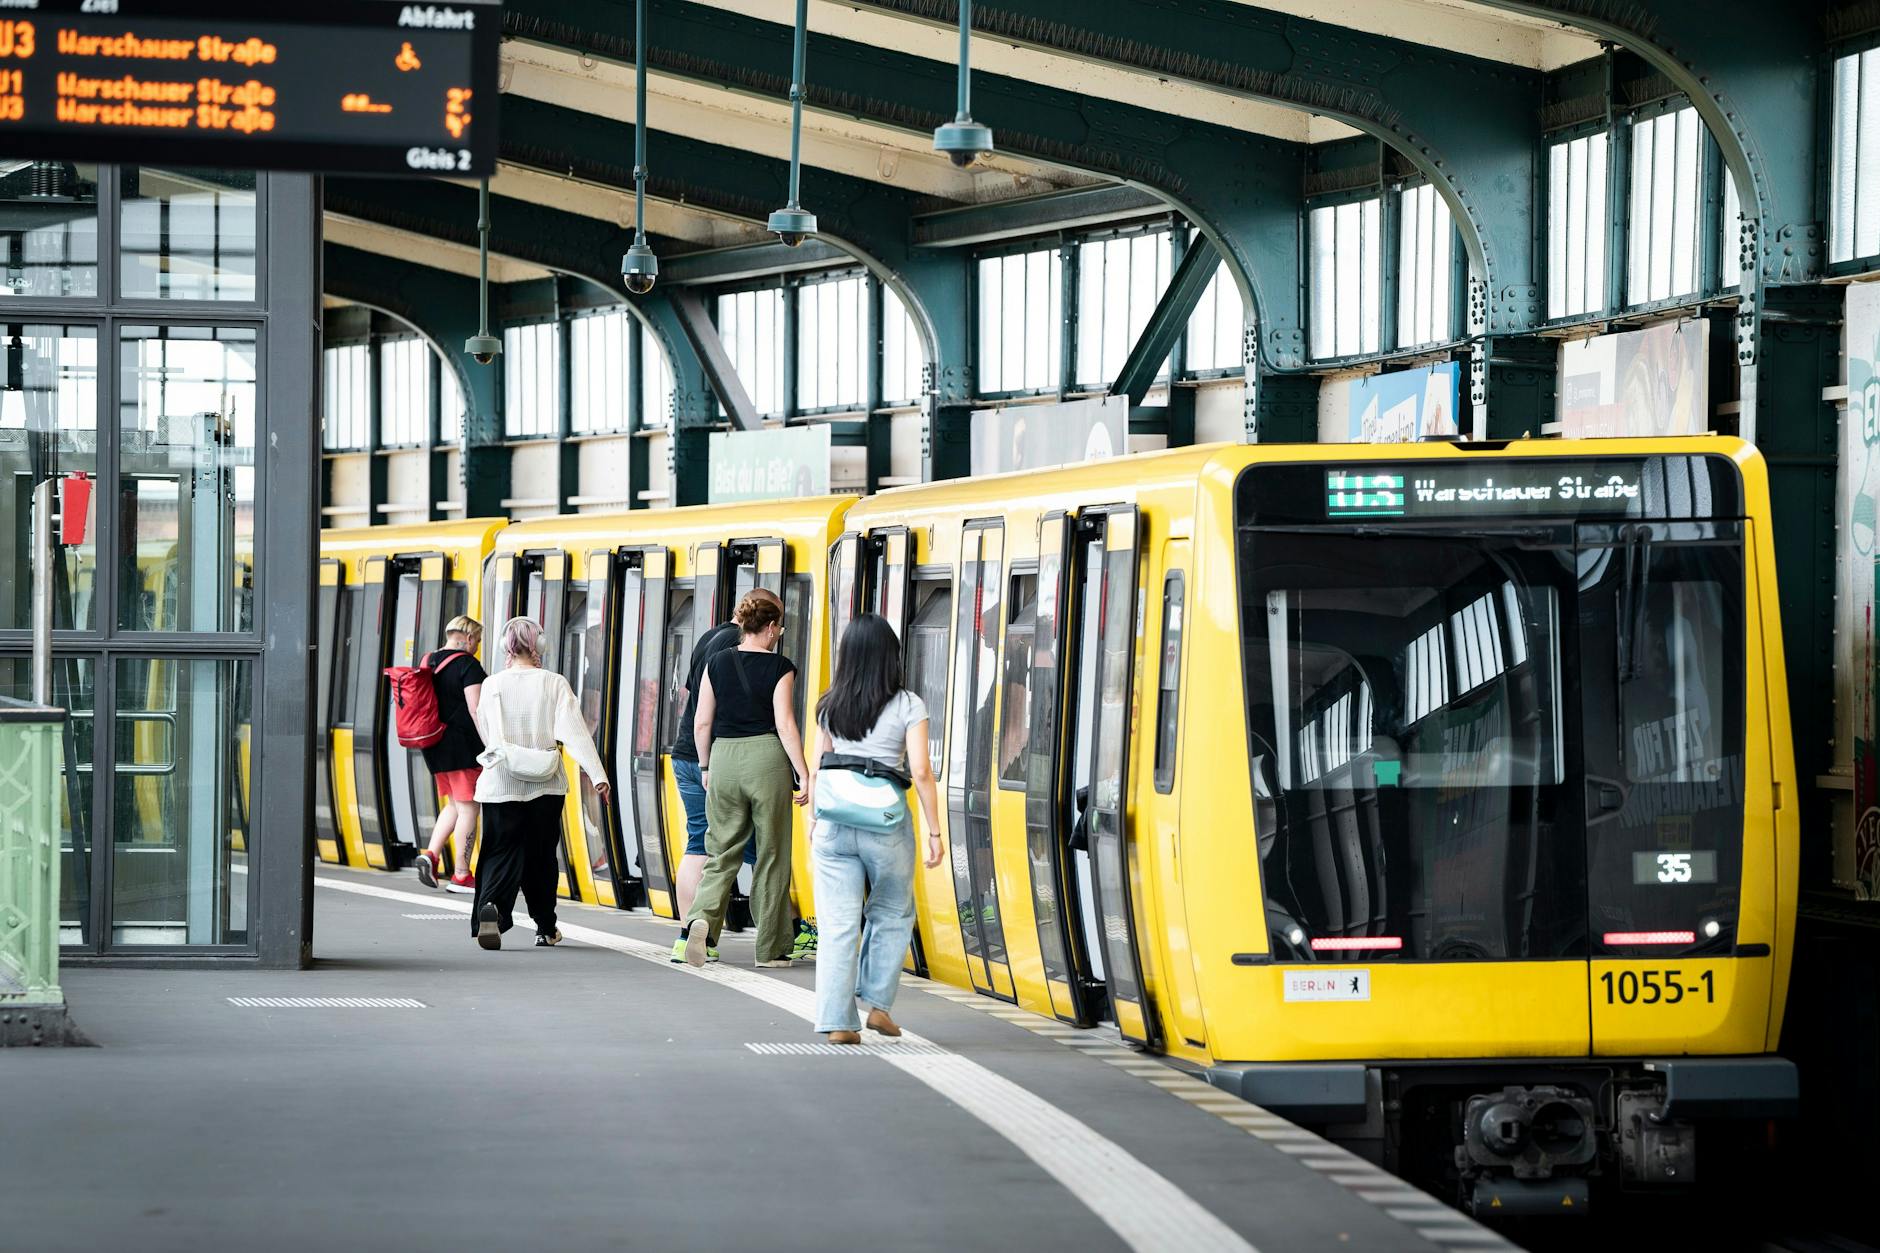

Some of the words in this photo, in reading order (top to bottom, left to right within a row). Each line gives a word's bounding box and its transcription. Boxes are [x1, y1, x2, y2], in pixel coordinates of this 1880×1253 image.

[399, 6, 475, 30] Abfahrt
[0, 19, 35, 58] U3
[57, 29, 195, 60] Warschauer
[197, 35, 277, 66] Straße
[57, 72, 194, 102] Warschauer
[196, 78, 276, 106] Straße
[56, 97, 194, 128] Warschauer
[196, 104, 275, 134] Straße
[406, 147, 456, 170] Gleis
[457, 149, 472, 170] 2
[714, 457, 736, 495] Bist
[737, 459, 753, 494] du
[753, 457, 766, 493] in
[1415, 478, 1552, 502] Warschauer
[1558, 476, 1640, 499] Straße
[1657, 853, 1692, 883] 35
[1293, 980, 1336, 992] BERLIN
[1600, 969, 1717, 1005] 1055-1
